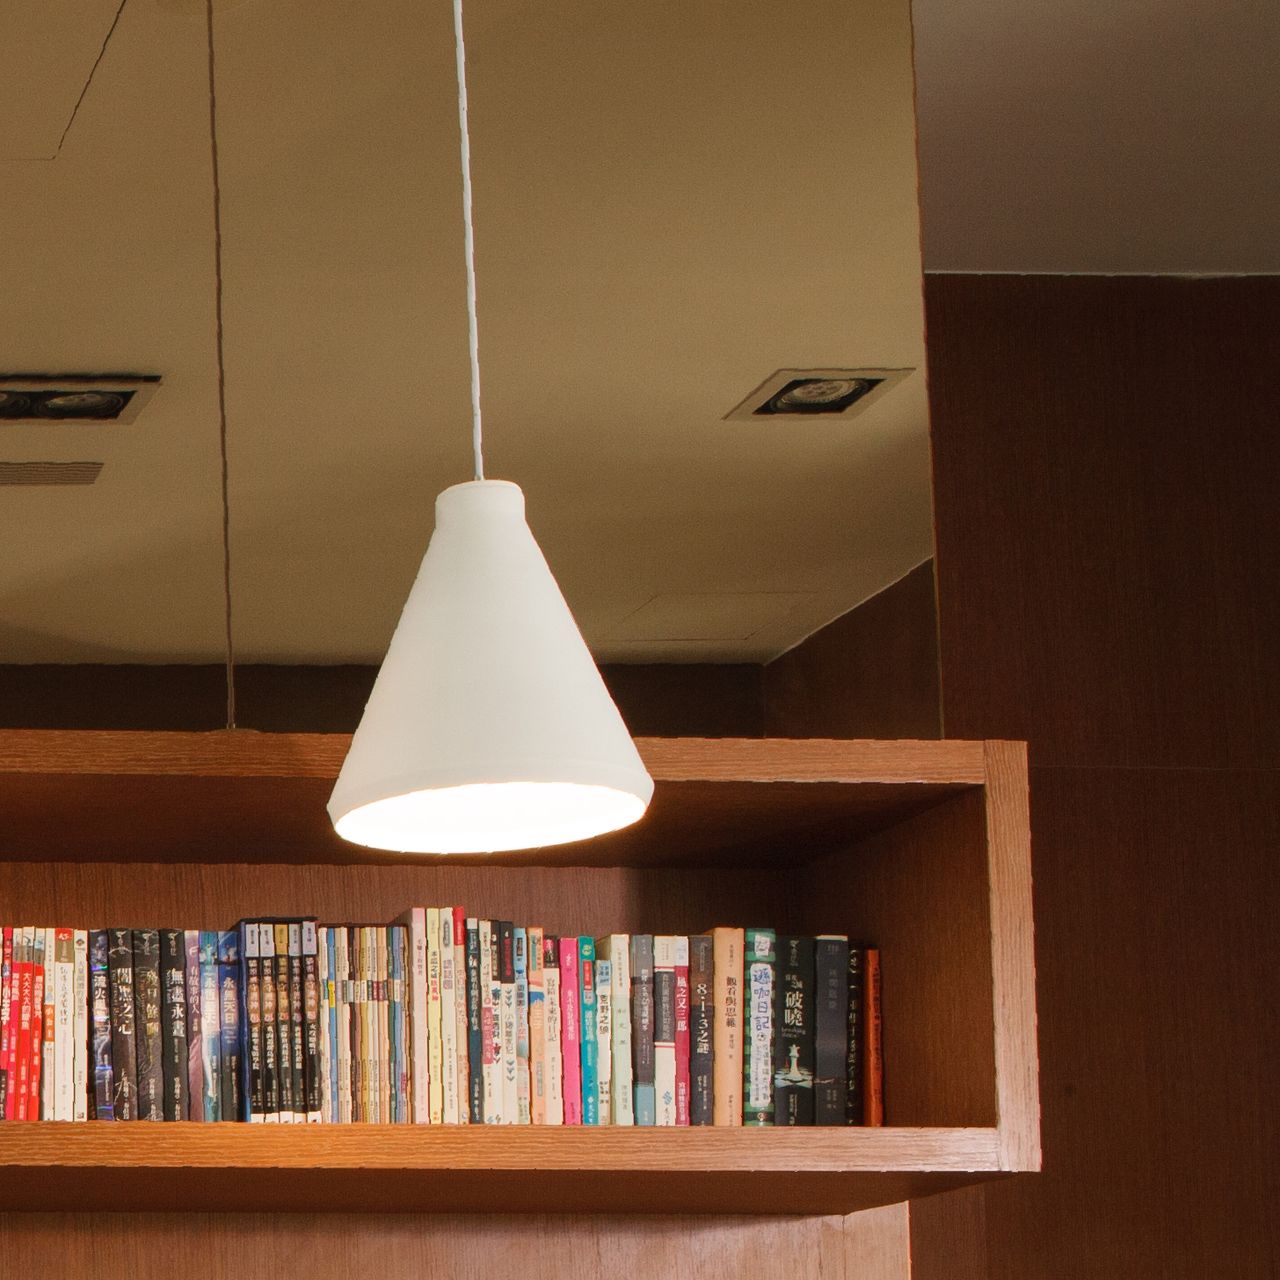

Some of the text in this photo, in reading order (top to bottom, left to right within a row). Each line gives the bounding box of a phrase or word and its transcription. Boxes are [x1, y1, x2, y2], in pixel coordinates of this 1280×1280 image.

[171, 967, 185, 1037] 無盡永晝
[751, 967, 771, 1032] 遜咖日記
[784, 991, 804, 1027] 破曉
